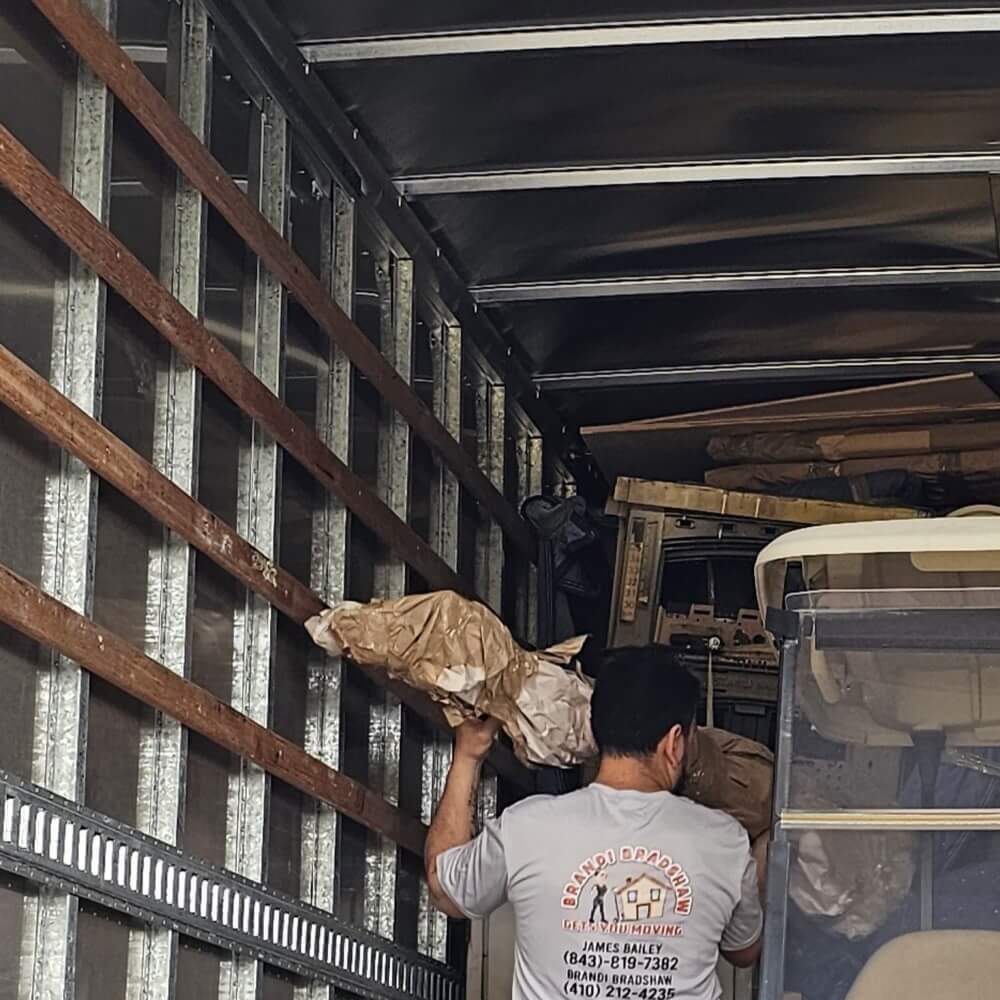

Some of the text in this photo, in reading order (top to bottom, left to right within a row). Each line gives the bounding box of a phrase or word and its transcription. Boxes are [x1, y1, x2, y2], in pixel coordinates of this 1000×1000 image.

[561, 846, 693, 915] BRANDI BRADSHAW
[631, 923, 683, 937] MOVING
[582, 941, 663, 955] JAMES BAILEY
[563, 951, 679, 971] (843)-819-7382
[567, 969, 672, 986] BRANDI BRADSHAW
[563, 981, 675, 1000] (410) 212-4235
